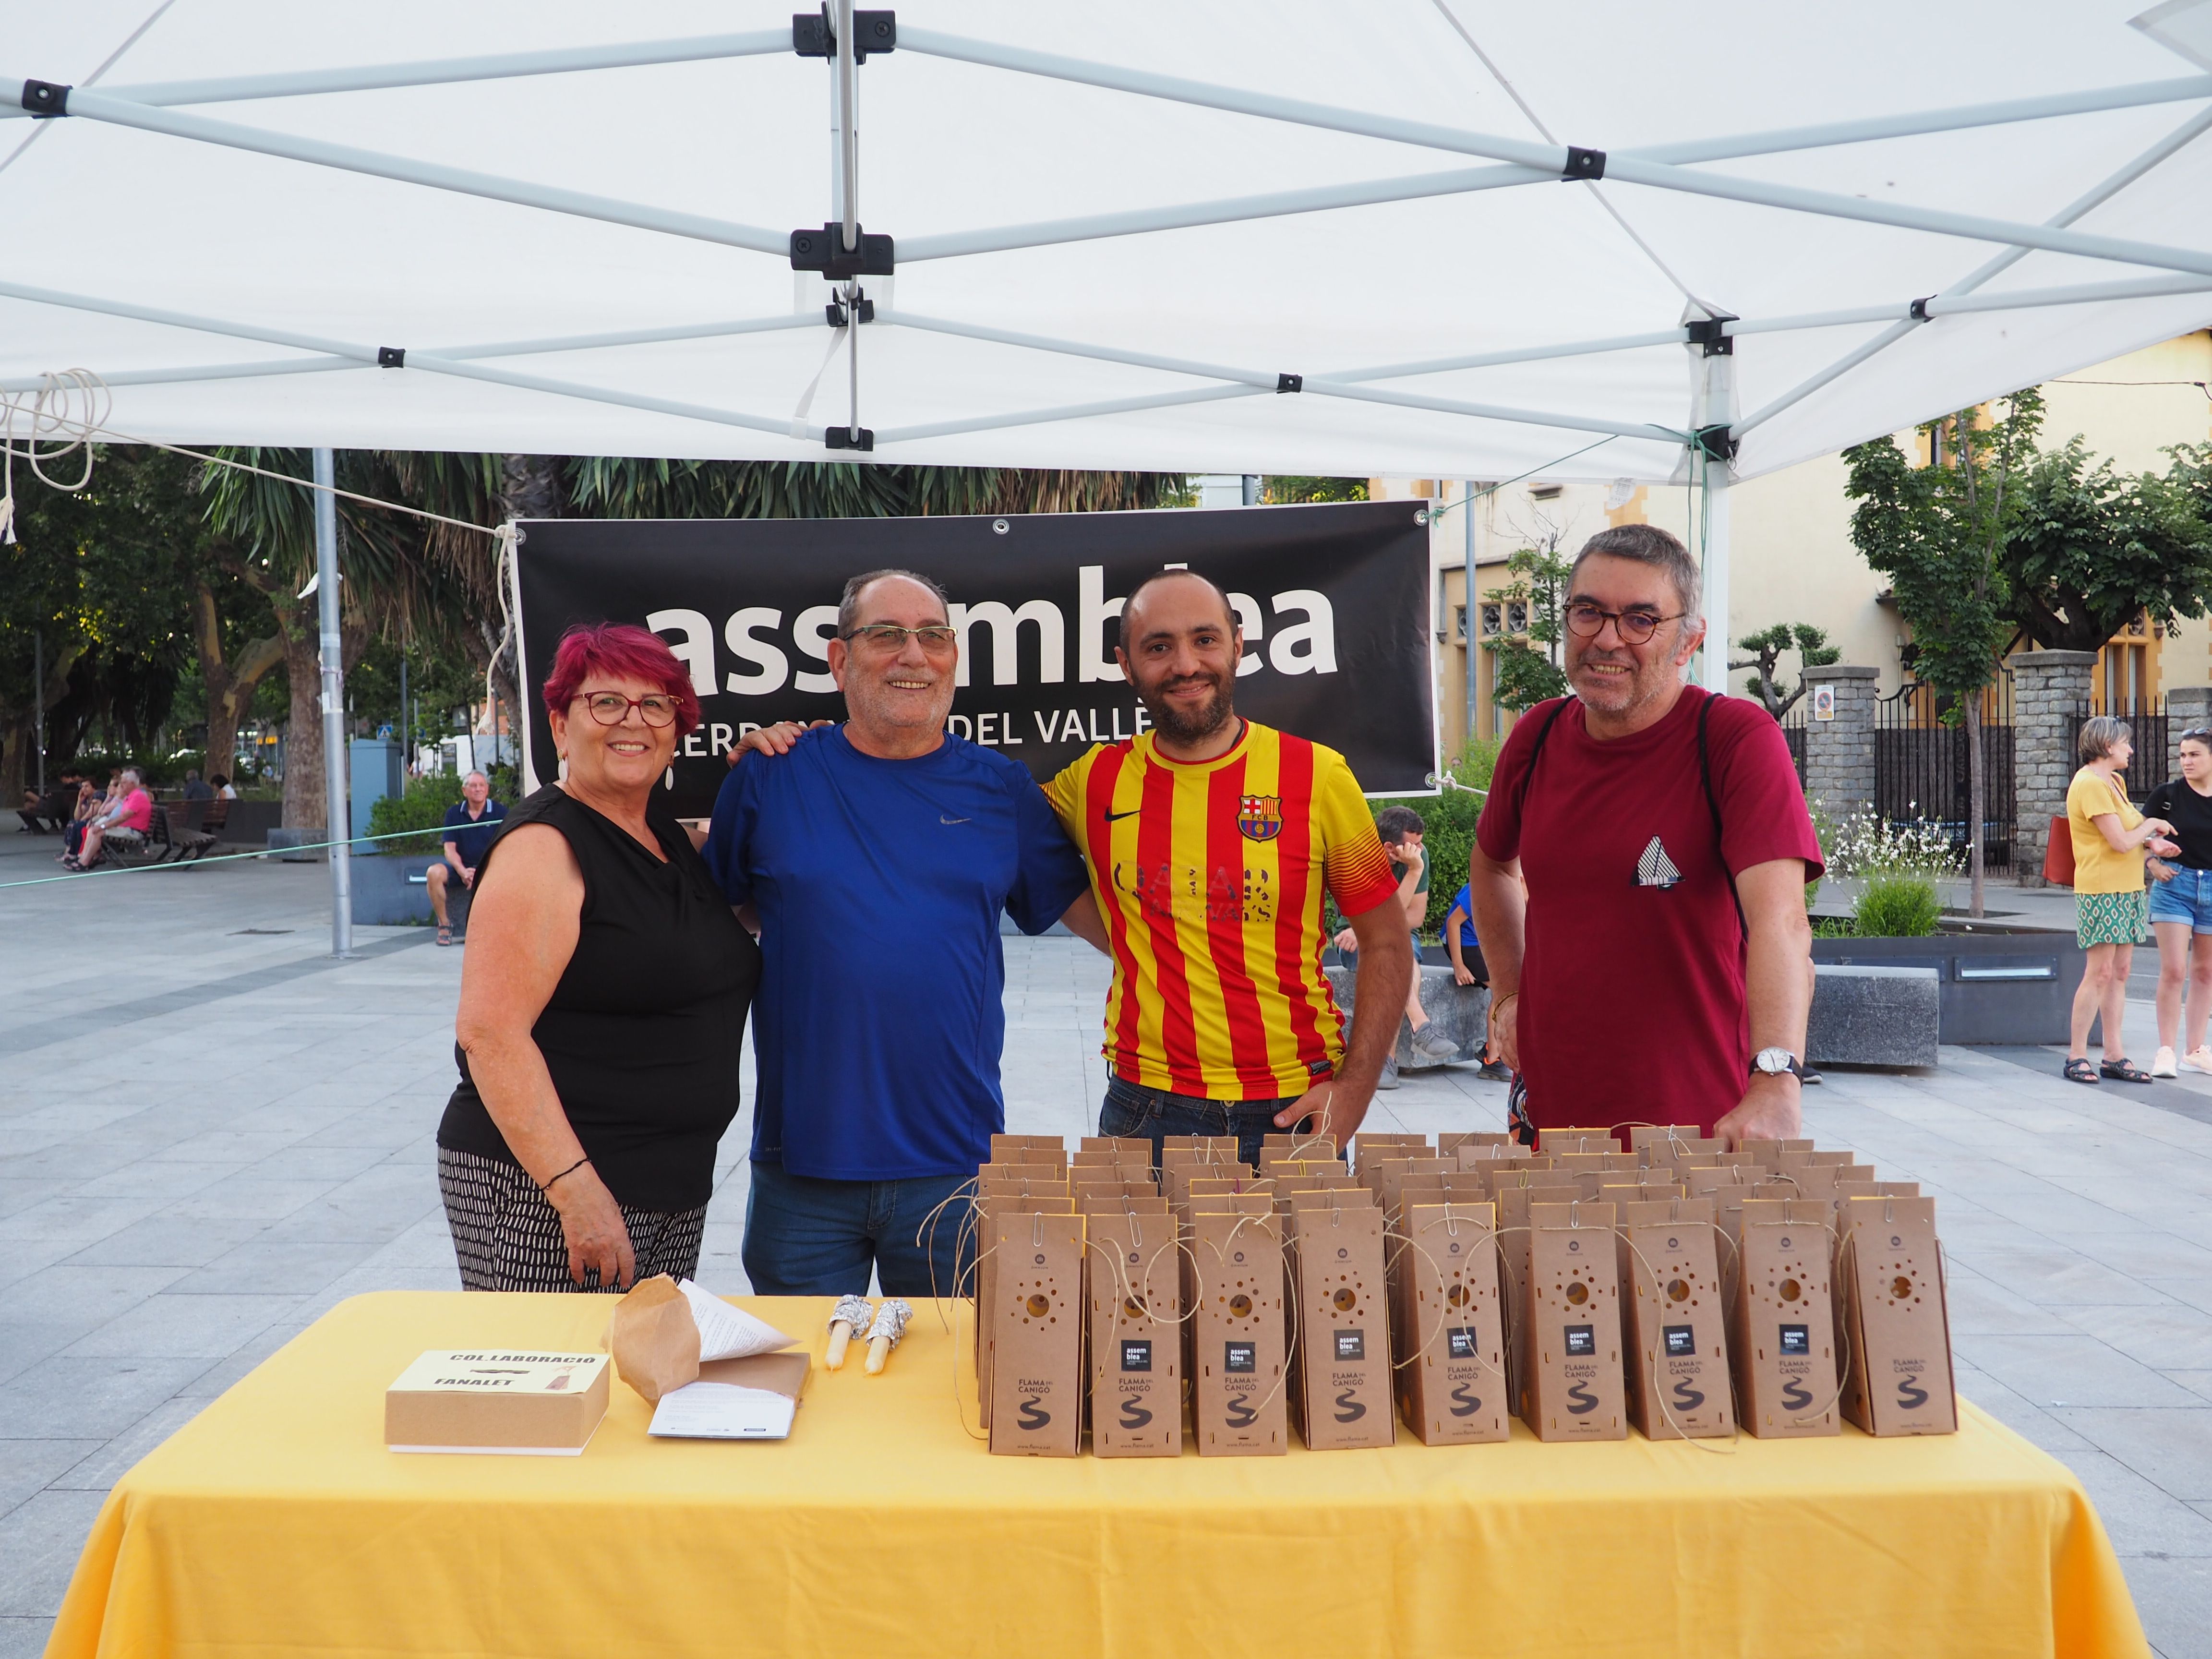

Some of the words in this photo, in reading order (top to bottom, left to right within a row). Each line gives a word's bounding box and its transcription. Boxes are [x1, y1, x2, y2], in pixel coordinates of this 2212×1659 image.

[645, 563, 1338, 697] assmba
[948, 712, 1023, 745] DEL
[1034, 697, 1152, 743] VALLÈ
[1448, 1371, 1478, 1380] CANIGÓ
[1119, 1384, 1151, 1392] CANIGÓ
[1225, 1383, 1256, 1391] CANIGÓ
